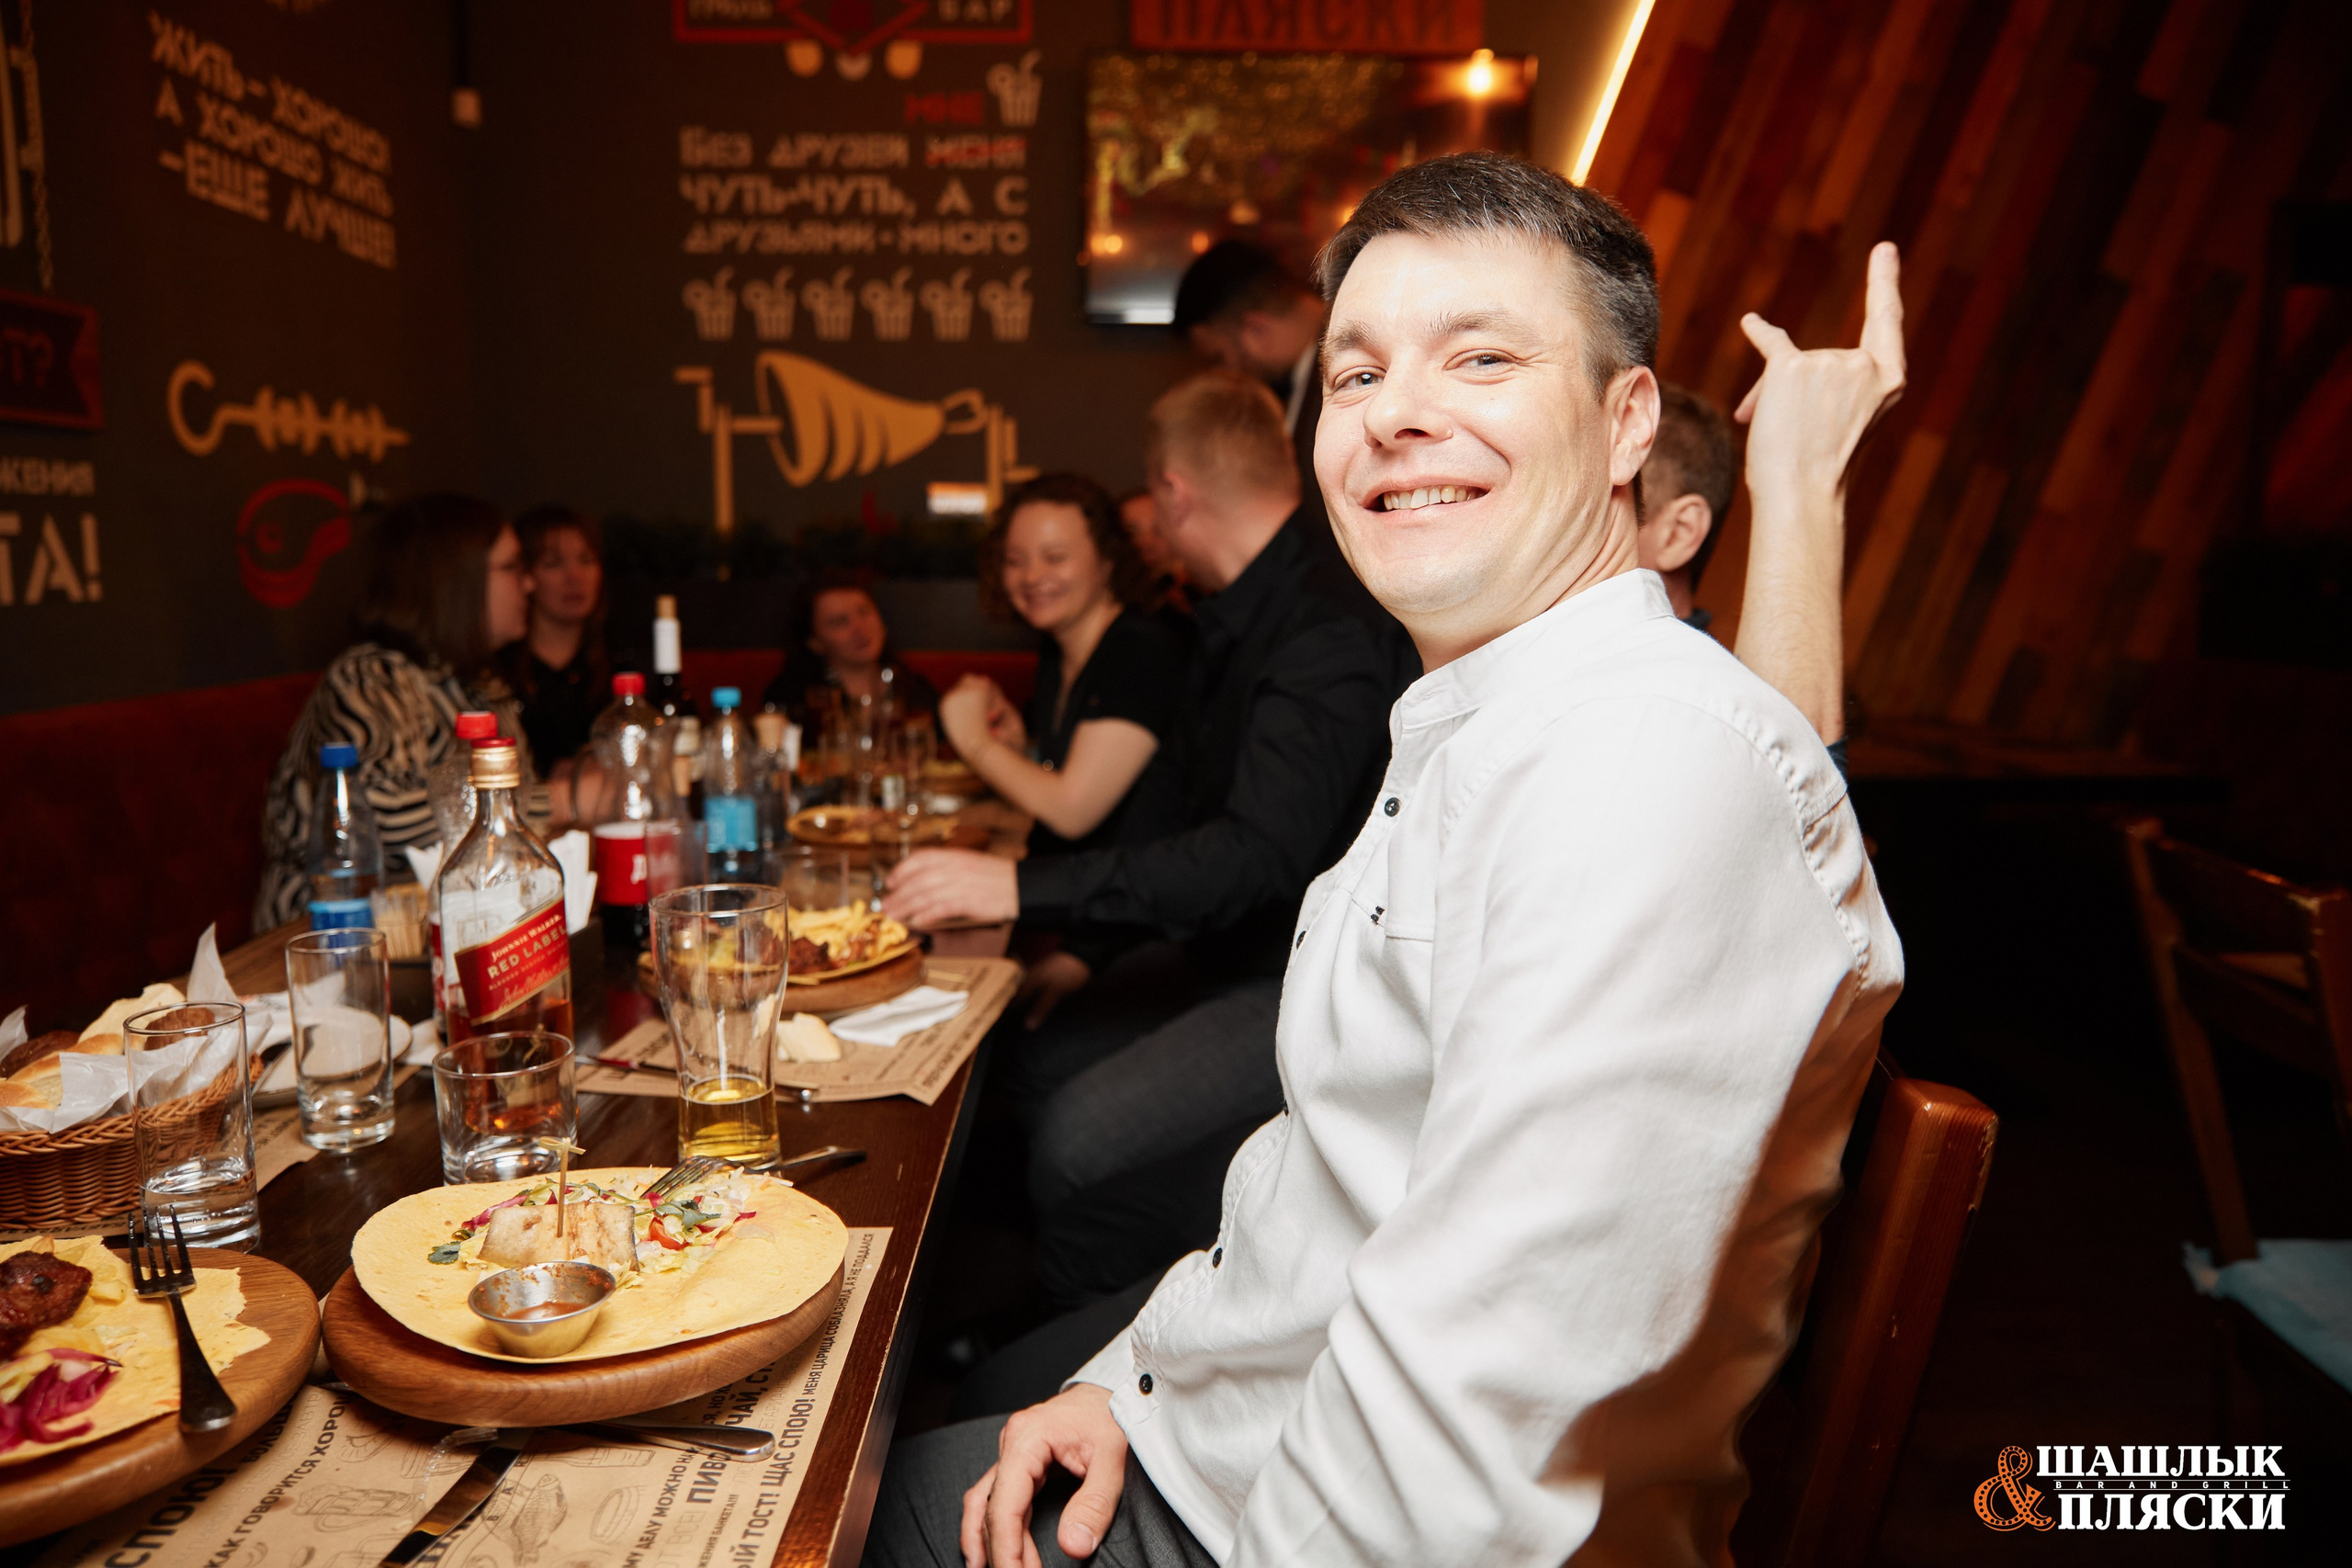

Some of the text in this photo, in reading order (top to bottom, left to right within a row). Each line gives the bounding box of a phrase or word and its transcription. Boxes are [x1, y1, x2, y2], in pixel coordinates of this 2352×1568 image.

[148, 9, 246, 103] ЖИТЬ
[269, 73, 393, 175] ХОРОШО
[155, 74, 396, 219] А ХОРОШО ЖИТЬ
[935, 175, 975, 216] А
[992, 173, 1030, 217] С
[283, 184, 399, 271] ЛУЧШЕ
[897, 218, 1030, 256] МНОГО
[487, 953, 520, 980] RED
[523, 924, 566, 958] LABEL
[811, 1336, 836, 1371] ЦАРИЦА
[802, 1371, 822, 1395] МЕНЯ
[778, 1398, 816, 1449] СПОЮ!
[760, 1451, 796, 1487] ЩАС
[201, 1537, 247, 1568] КАК
[234, 1459, 322, 1533] ГОВОРИТСЯ
[634, 1520, 662, 1550] ДЕЛУ
[651, 1465, 687, 1517] МОЖНО
[714, 1494, 739, 1536] БАНКЕТА!!!
[741, 1492, 781, 1540] ТОСТ!
